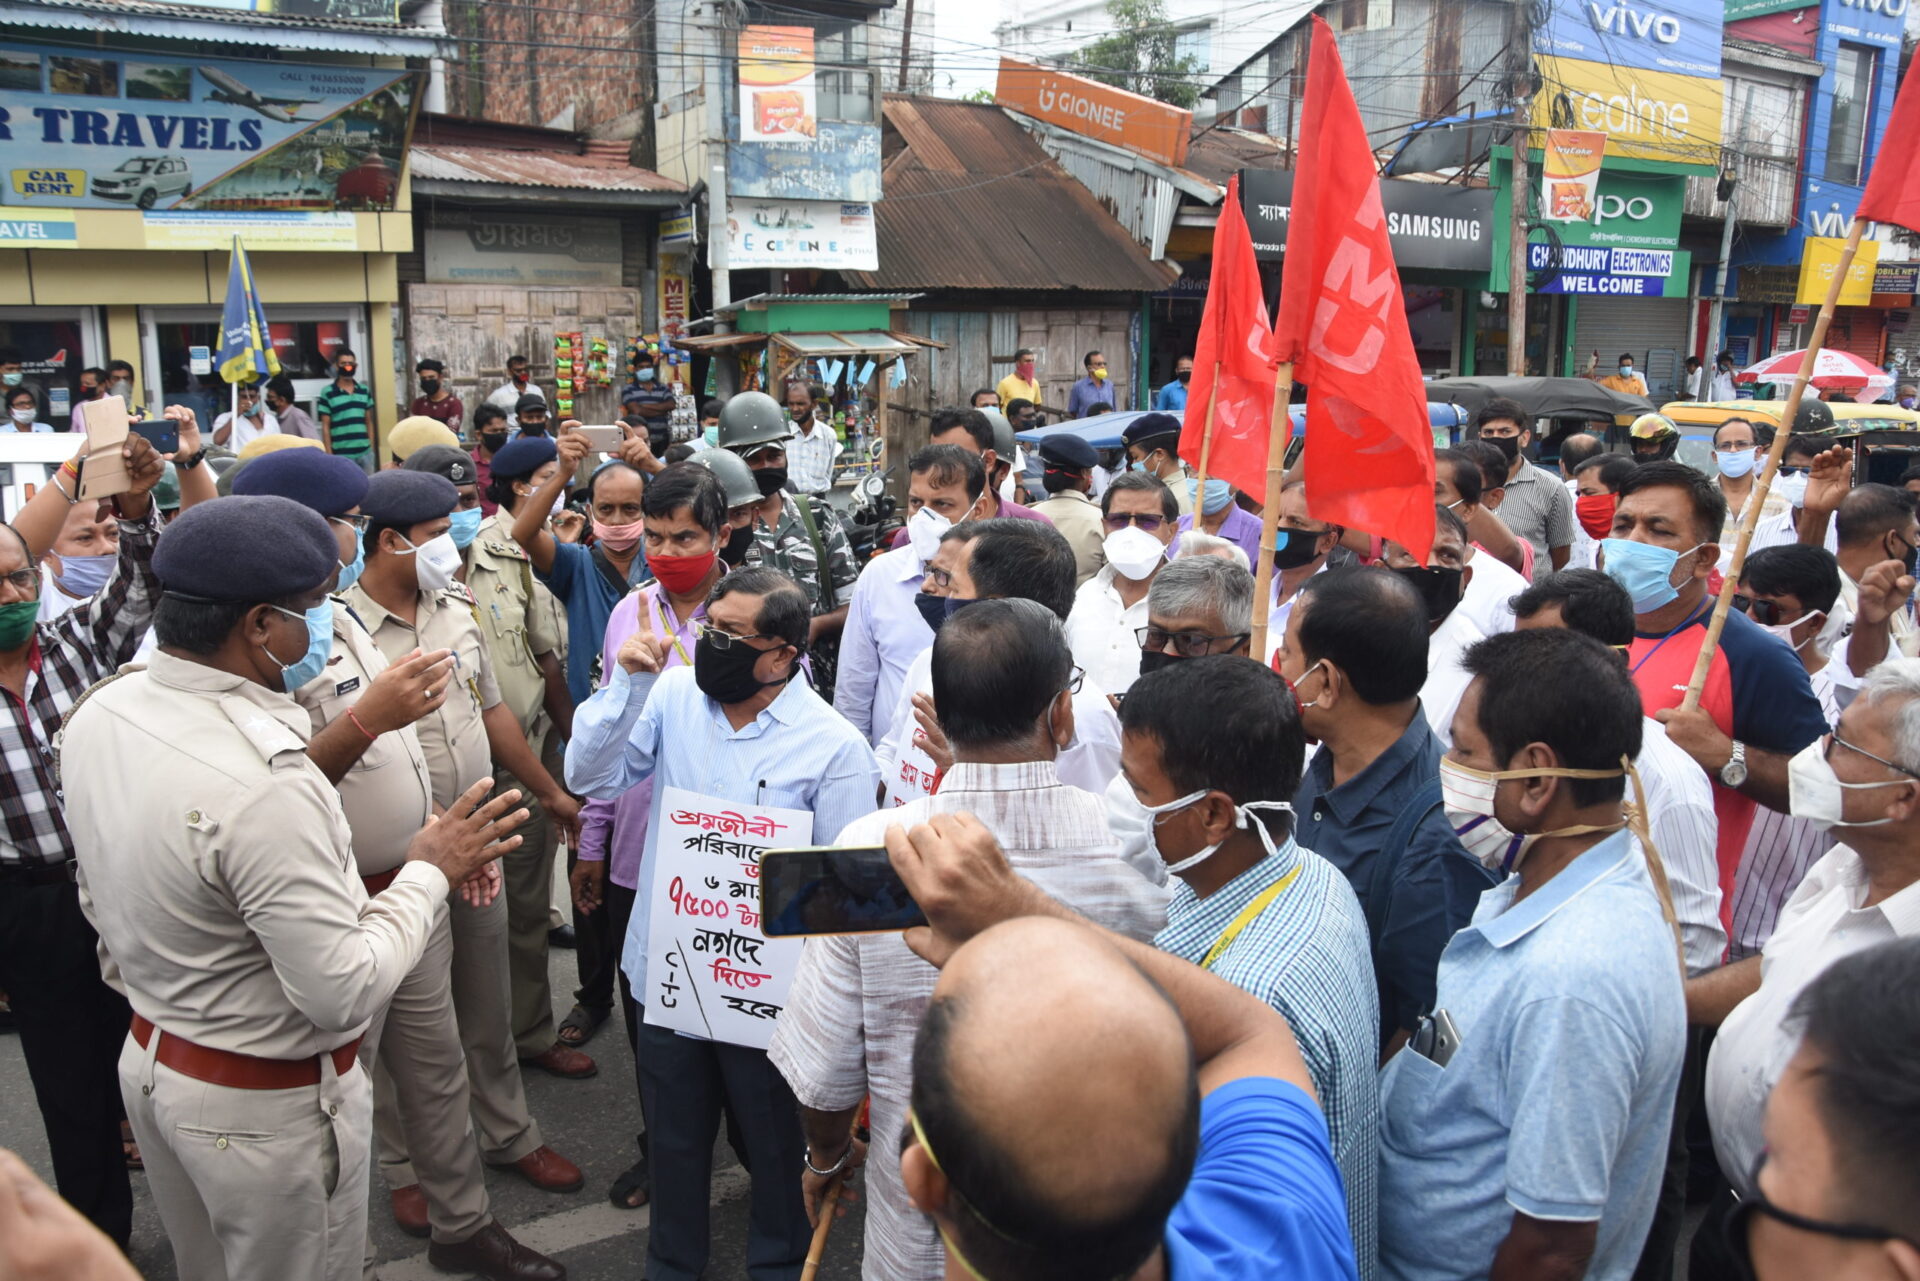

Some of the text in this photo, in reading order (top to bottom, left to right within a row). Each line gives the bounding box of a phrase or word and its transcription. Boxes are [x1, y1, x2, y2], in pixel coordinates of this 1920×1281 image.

[1589, 0, 1681, 44] vivo
[280, 72, 303, 80] CALL
[1058, 91, 1126, 132] GIONEE
[33, 107, 263, 152] TRAVELS
[23, 182, 74, 195] RENT
[28, 170, 68, 183] CAR
[1388, 211, 1480, 241] SAMSUNG
[1613, 251, 1671, 273] ELECTRONICS
[1562, 275, 1644, 294] WELCOME
[671, 810, 788, 838] শ্রমজীবী
[669, 875, 729, 919] ৭৫০০
[693, 928, 765, 966] নগদে
[707, 957, 772, 990] দিতে
[721, 995, 783, 1019] হবে
